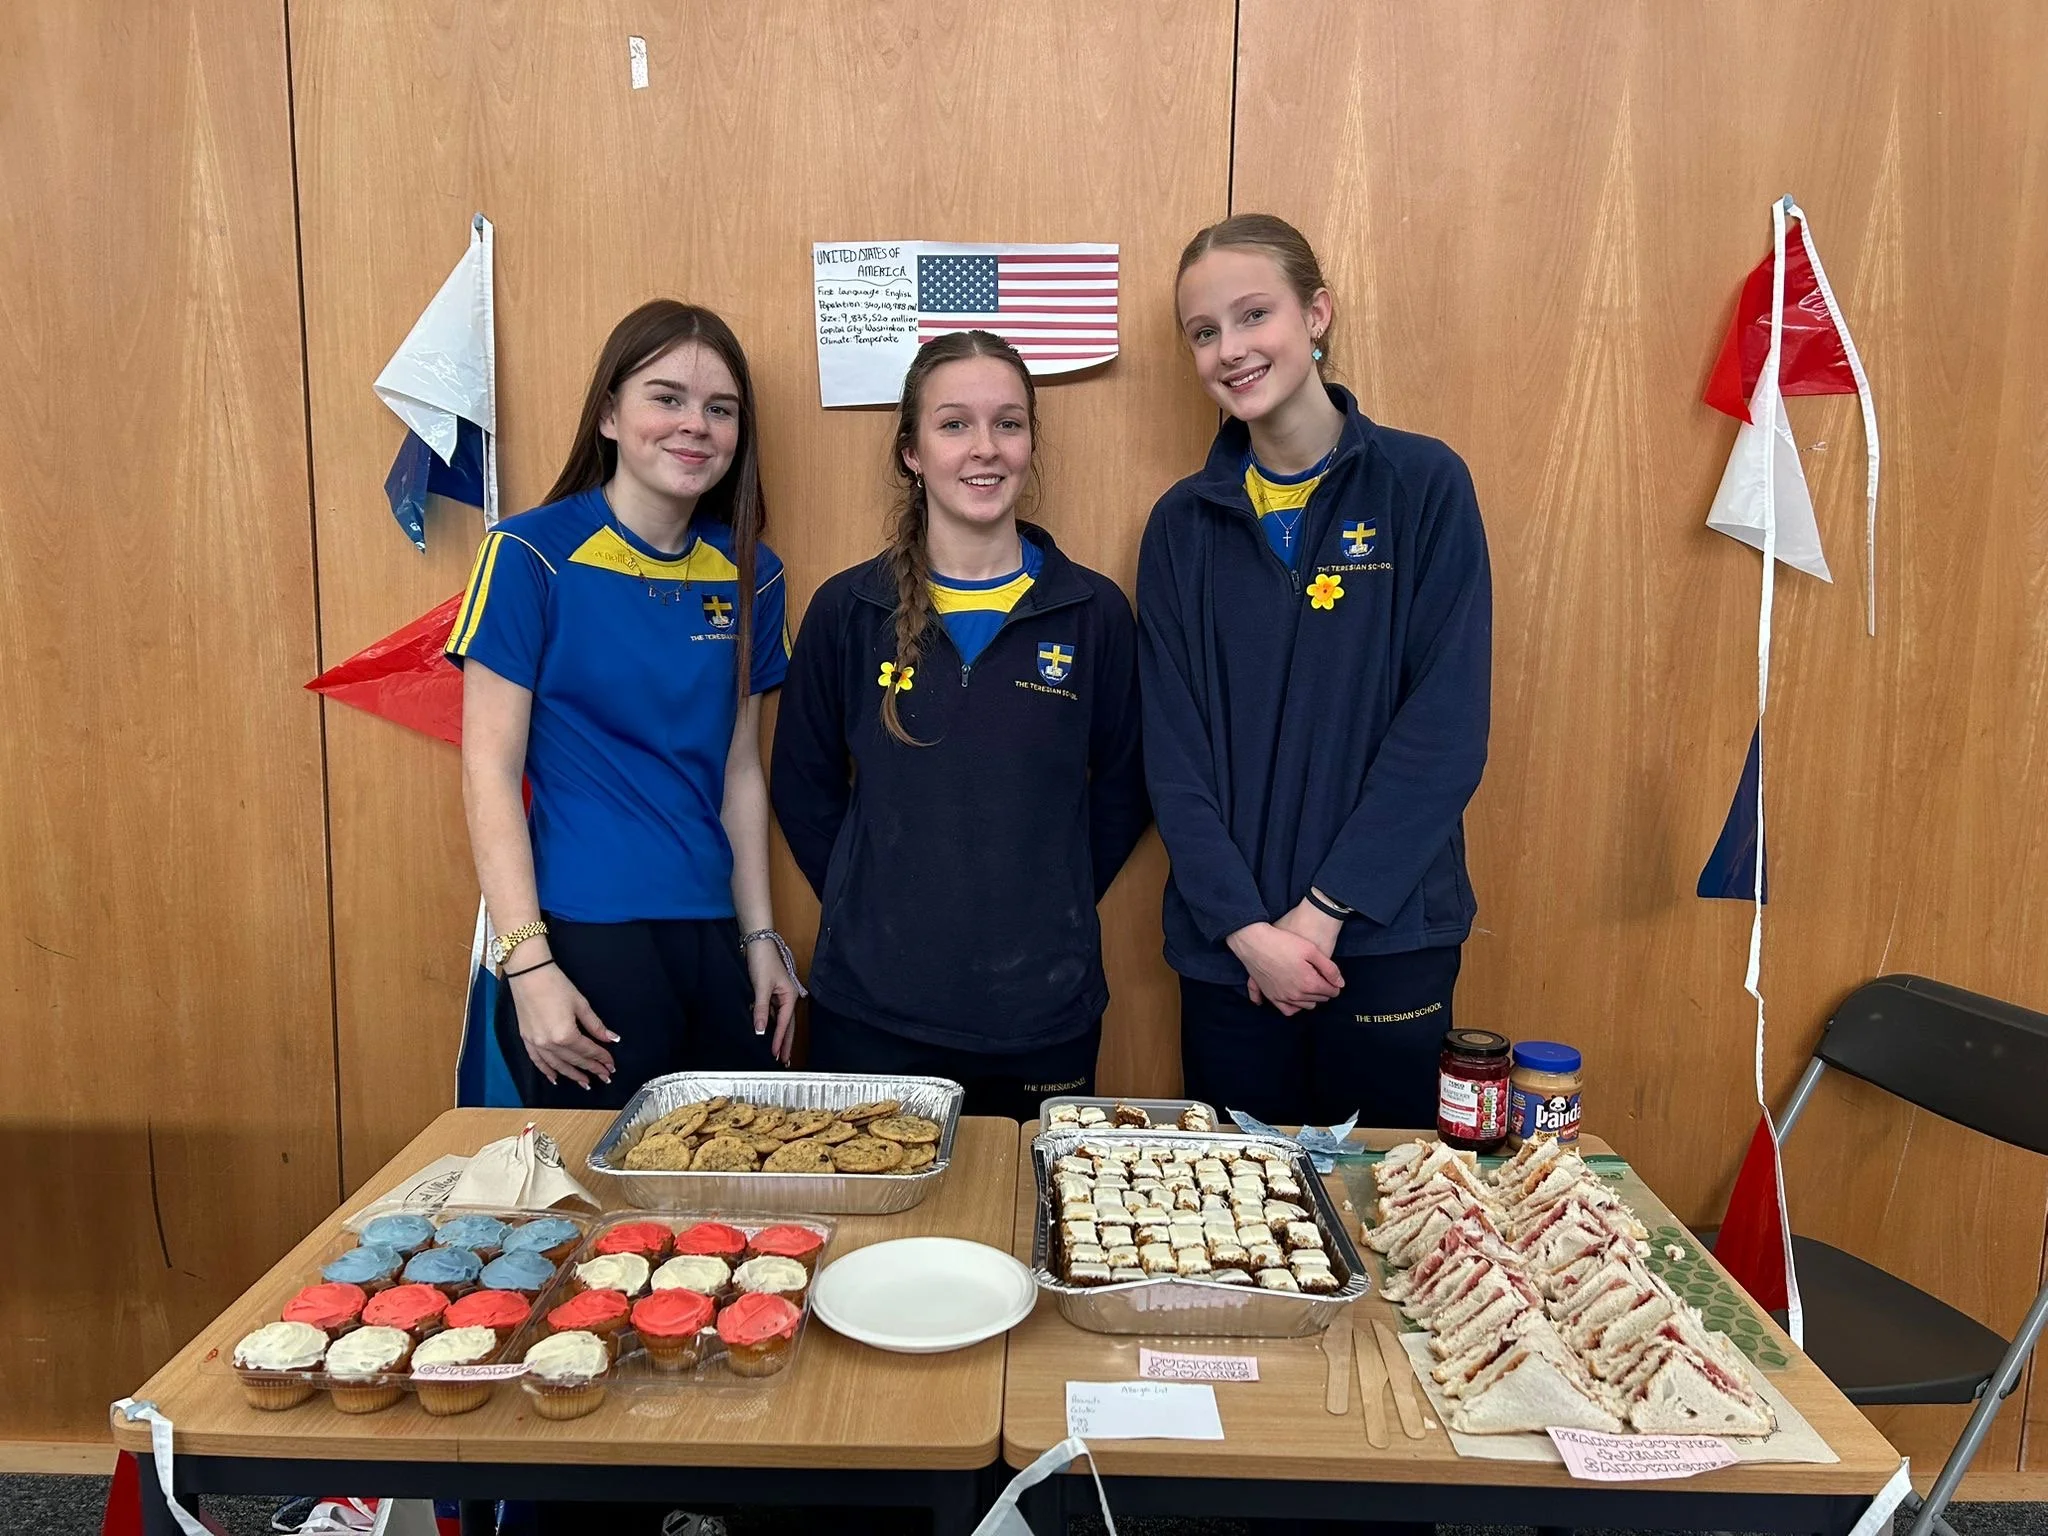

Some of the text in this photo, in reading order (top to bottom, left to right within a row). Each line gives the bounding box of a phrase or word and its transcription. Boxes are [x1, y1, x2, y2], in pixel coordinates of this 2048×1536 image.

[817, 247, 900, 265] UNITED STATES OF
[857, 265, 907, 277] AMERICA
[885, 288, 912, 300] English
[853, 333, 899, 346] Temperate
[1015, 680, 1029, 689] THE
[1355, 1001, 1443, 1023] THE TERESIAN SCHOOL
